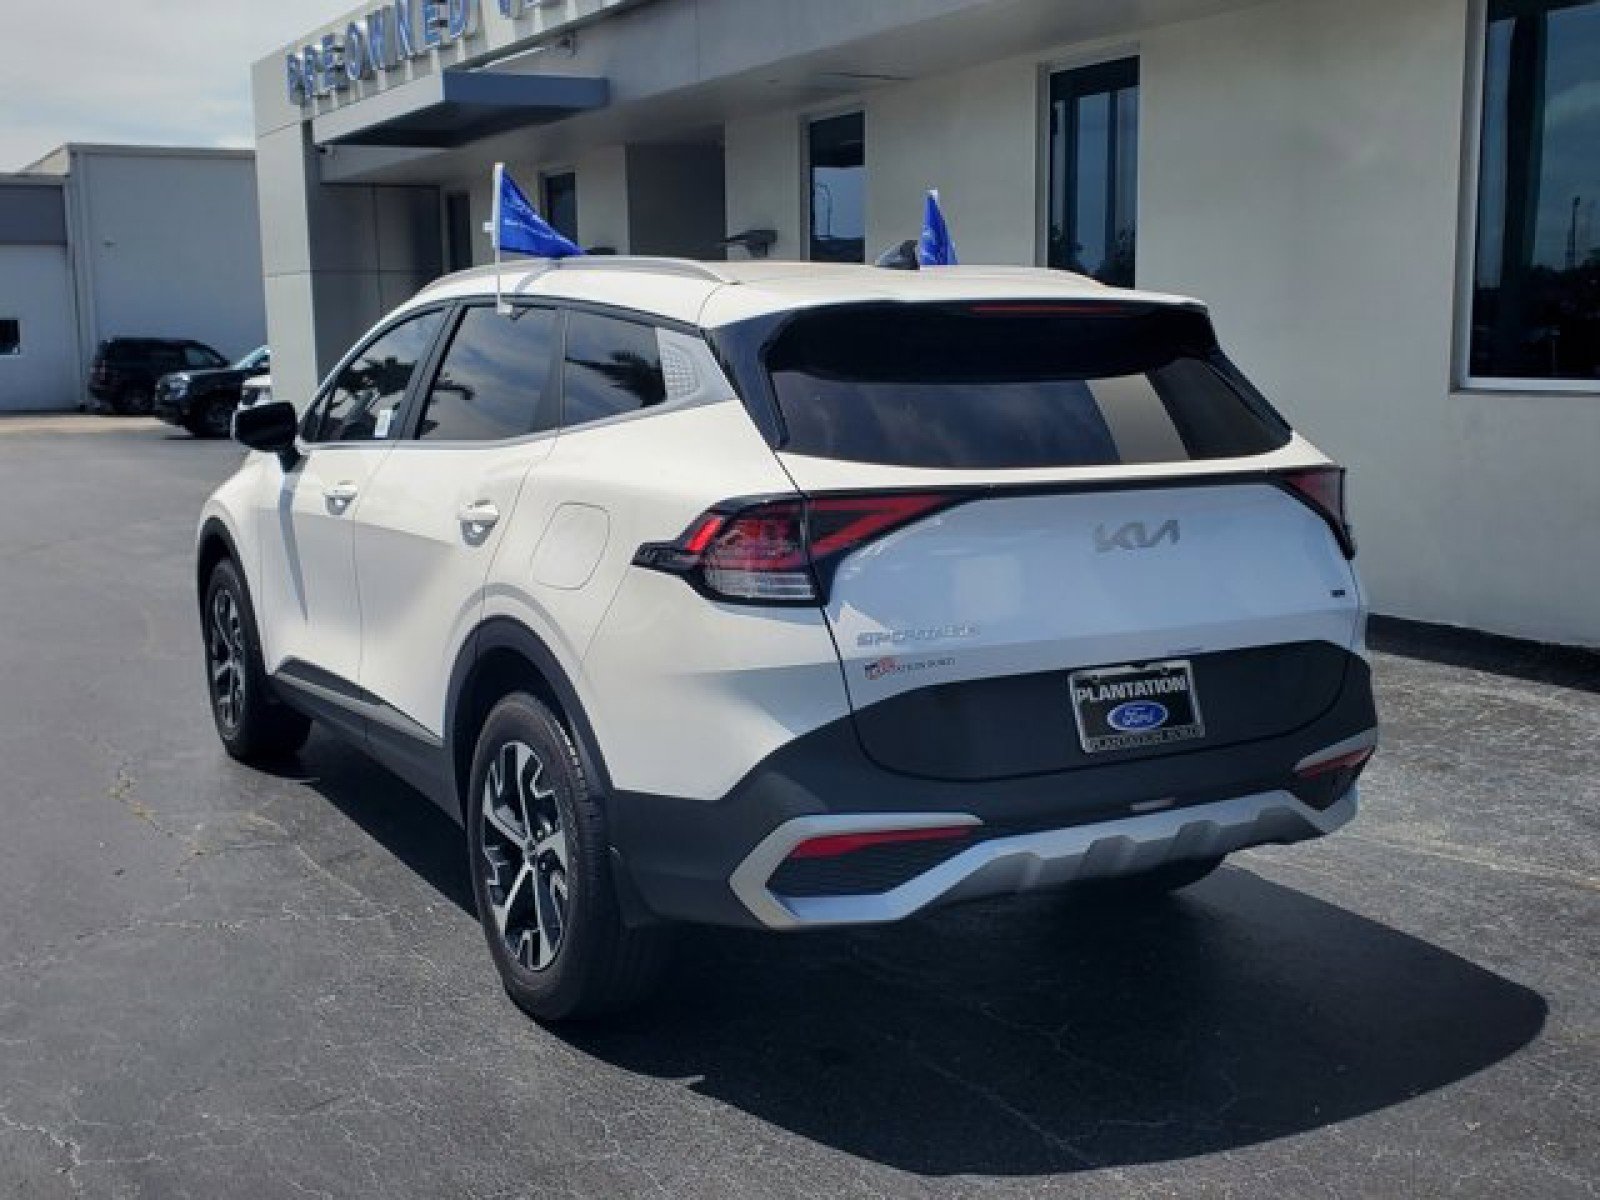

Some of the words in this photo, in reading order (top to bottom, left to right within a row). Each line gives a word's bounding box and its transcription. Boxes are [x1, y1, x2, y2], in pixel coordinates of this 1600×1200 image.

[286, 0, 475, 104] PREOWNED
[1096, 519, 1180, 552] KIA
[1076, 675, 1187, 703] PLANTATION
